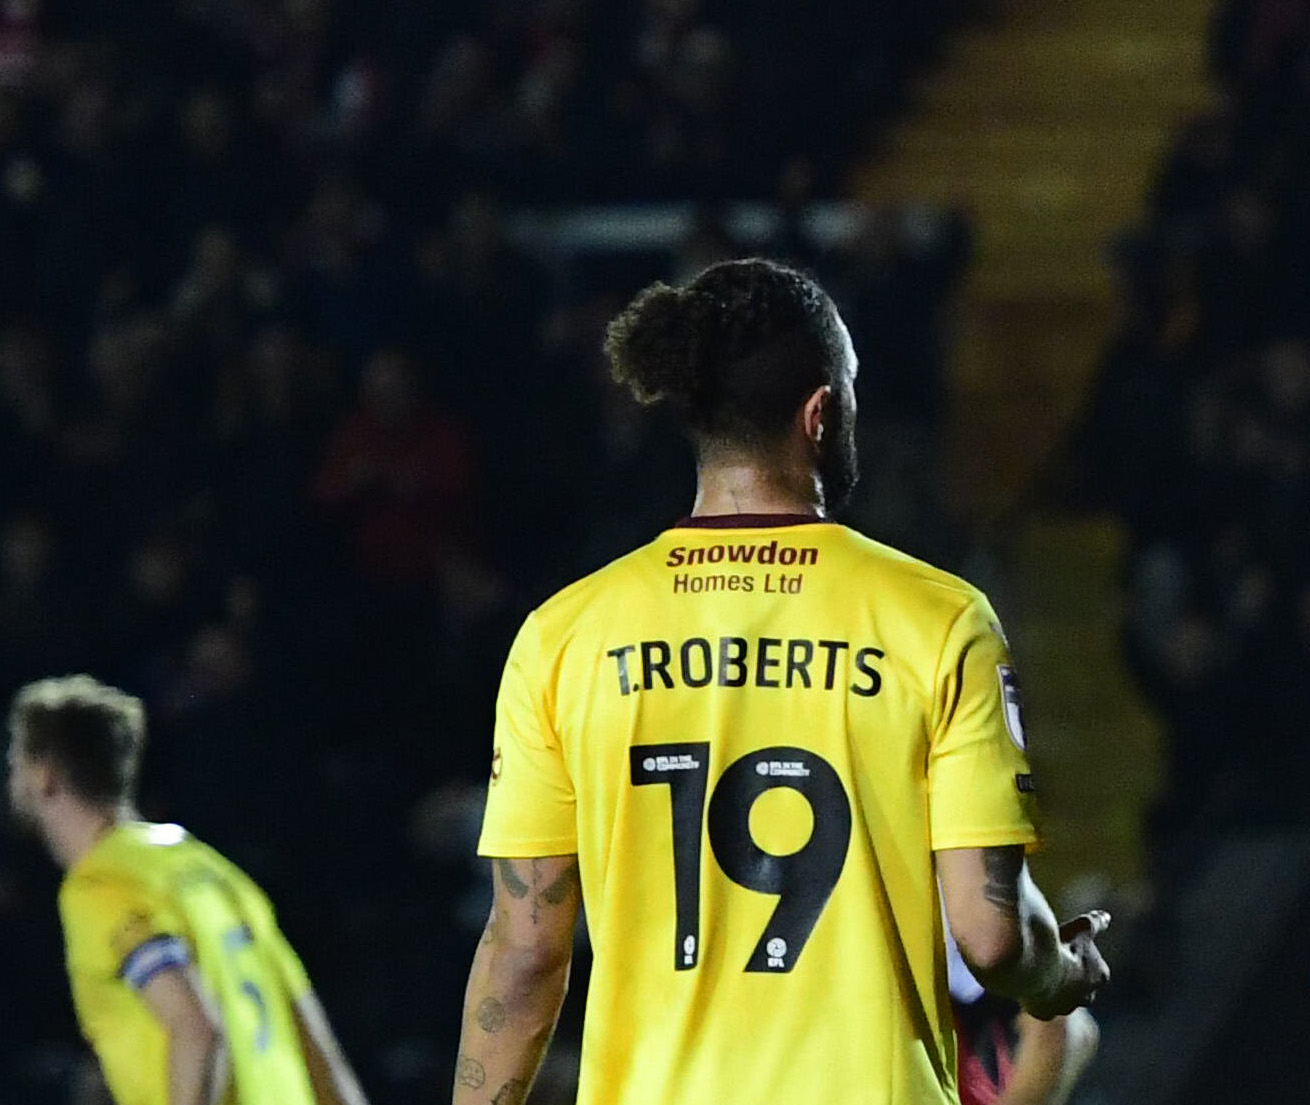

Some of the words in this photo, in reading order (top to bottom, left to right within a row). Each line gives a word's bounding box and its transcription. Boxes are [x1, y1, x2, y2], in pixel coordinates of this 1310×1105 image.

[666, 540, 819, 567] Snowdon
[673, 574, 754, 594] Homes
[764, 573, 803, 594] Ltd
[607, 637, 885, 697] T.ROBERTS
[629, 741, 852, 973] 19
